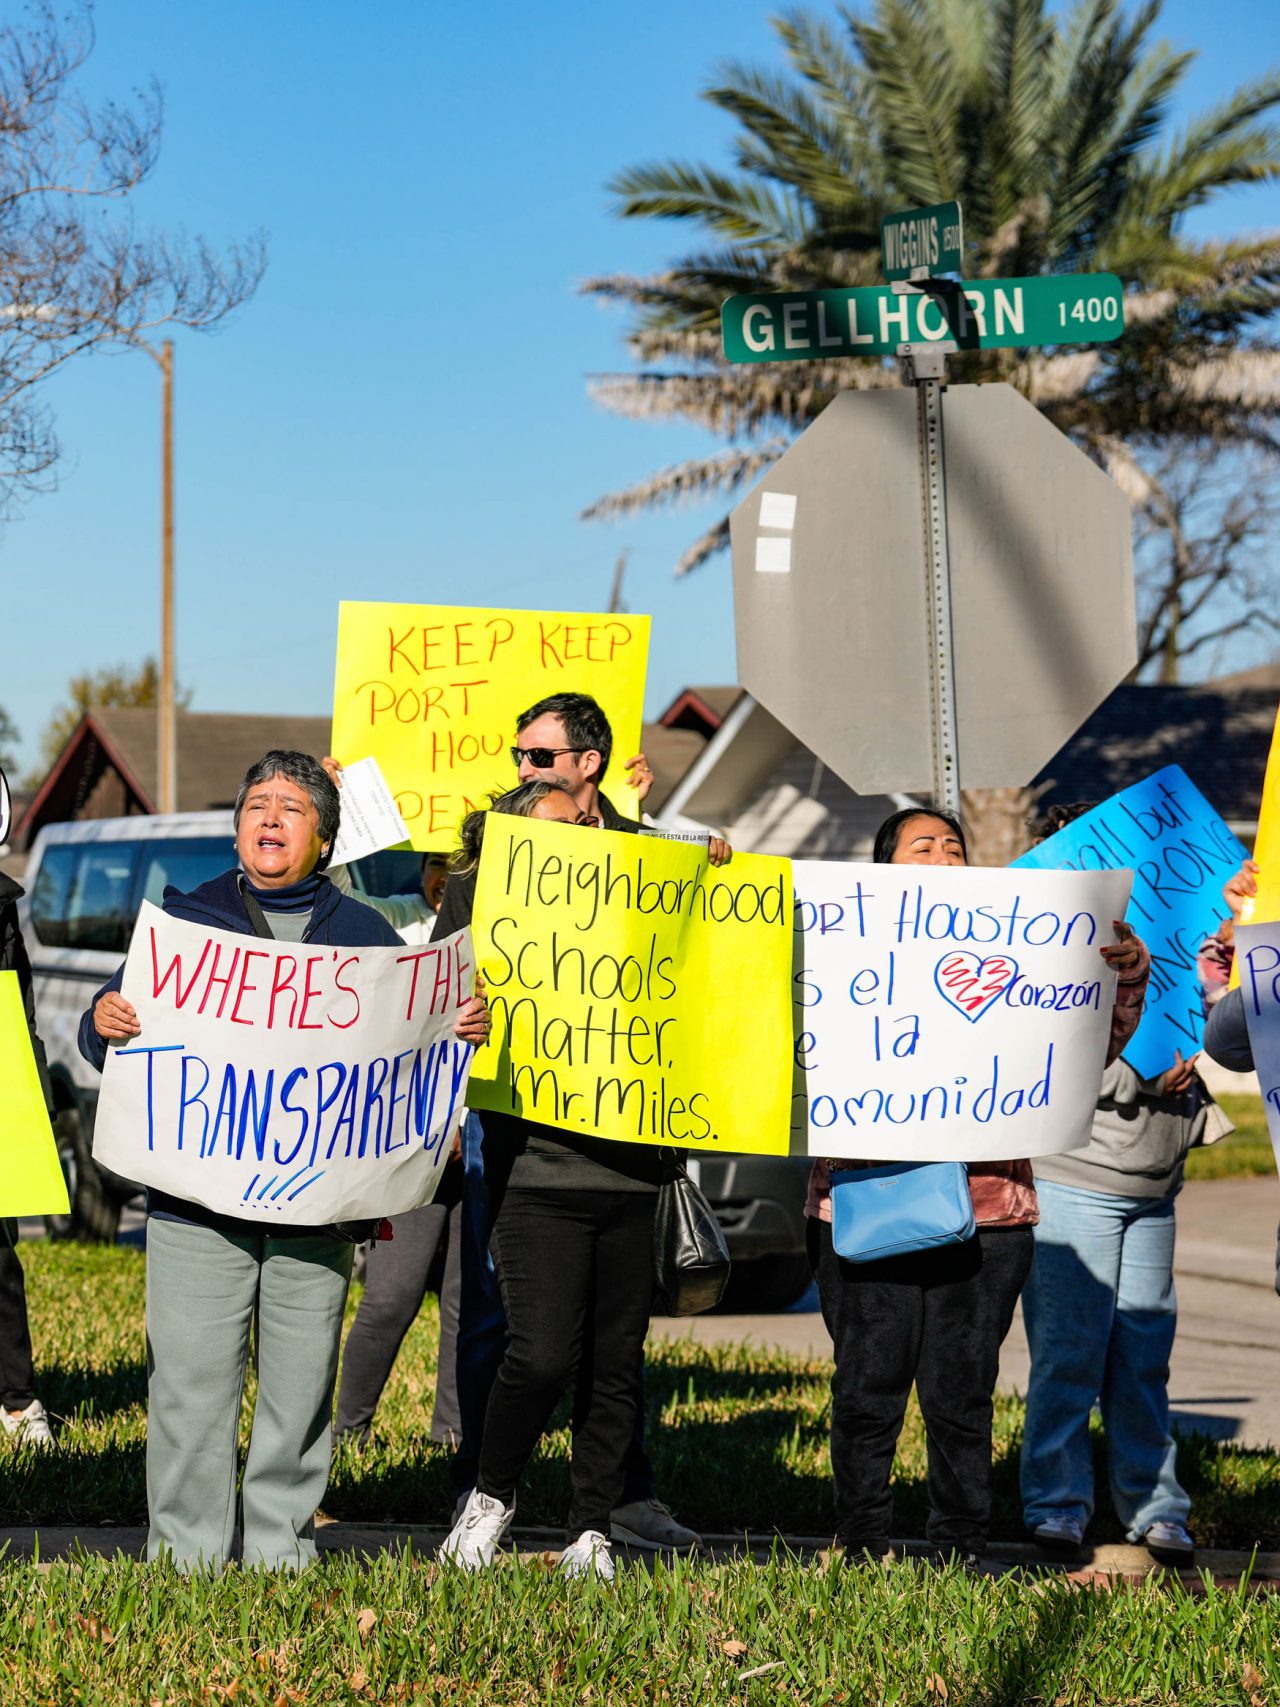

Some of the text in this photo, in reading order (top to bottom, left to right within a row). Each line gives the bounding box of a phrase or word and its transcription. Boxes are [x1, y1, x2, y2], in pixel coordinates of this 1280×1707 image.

[883, 215, 939, 271] WIGGINS
[741, 287, 1118, 353] GELLHORN 1400
[388, 617, 632, 676] KEEP KEEP
[355, 680, 489, 725] PORT
[431, 730, 520, 772] HOU
[1057, 783, 1192, 870] all but
[793, 882, 1096, 946] ORT Houston
[150, 926, 473, 1029] WHERE'S THE
[482, 917, 676, 1002] Schools
[850, 951, 895, 1005] el
[874, 1015, 920, 1062] la
[115, 1038, 472, 1168] TRANSPARENCY
